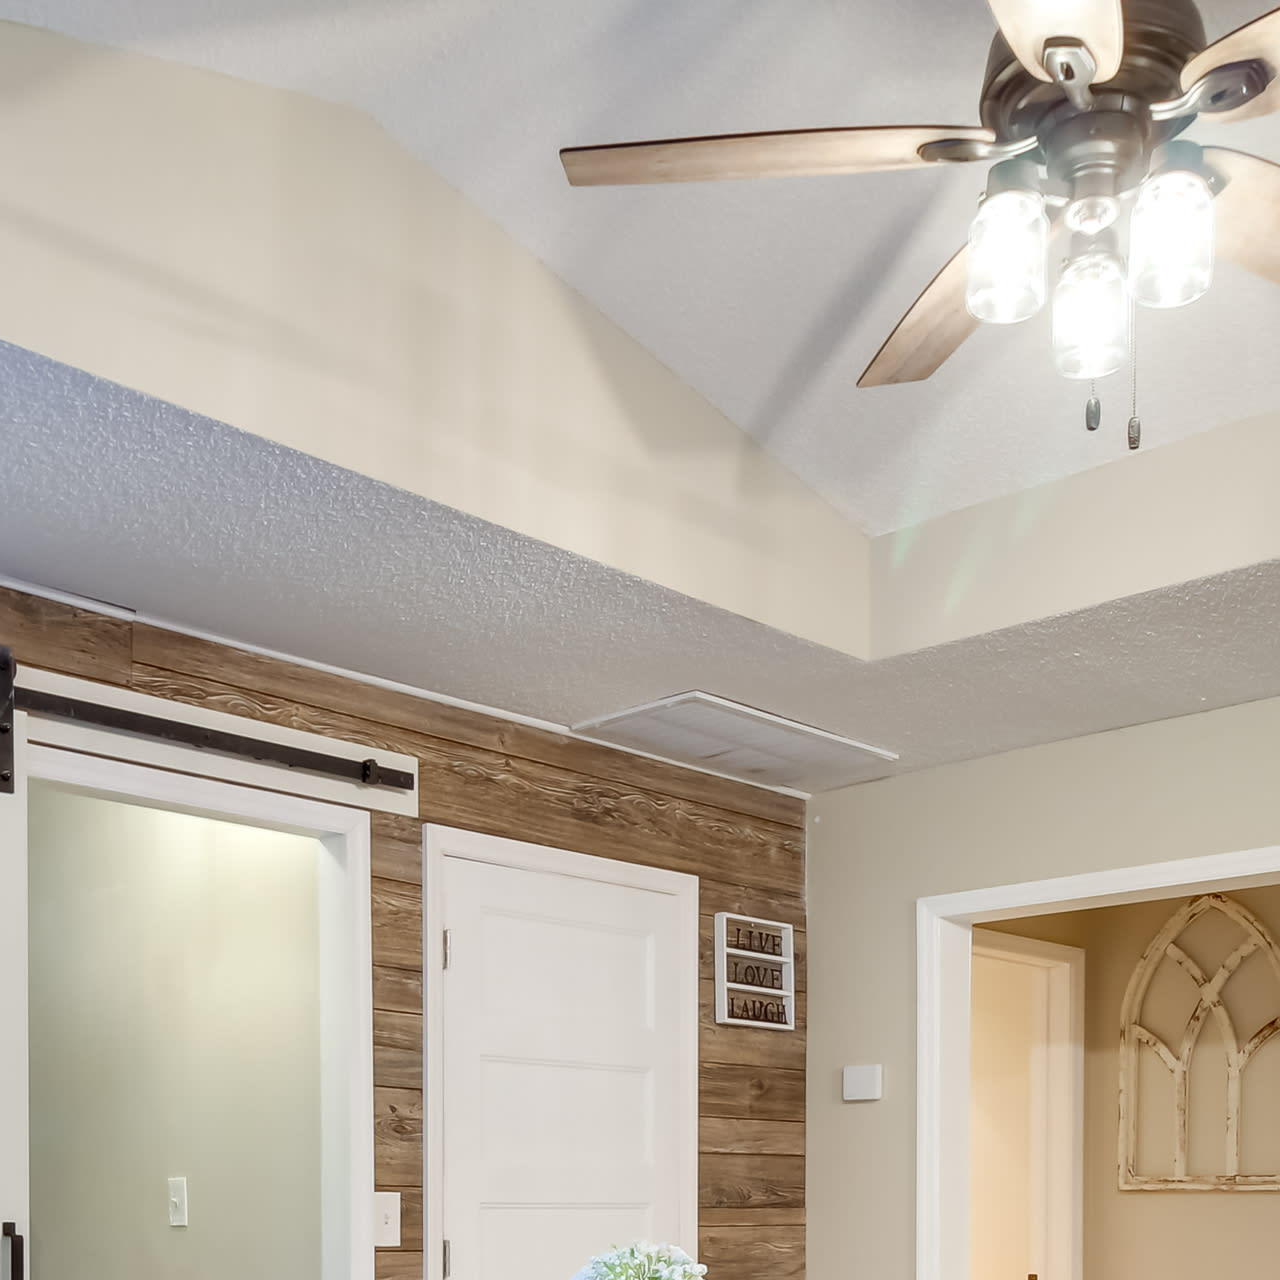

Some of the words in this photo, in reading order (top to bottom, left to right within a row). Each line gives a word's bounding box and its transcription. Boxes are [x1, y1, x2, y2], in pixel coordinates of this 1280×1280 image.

[736, 928, 783, 956] LIVE
[733, 962, 783, 990] LOVE
[729, 997, 788, 1025] LAUGH
